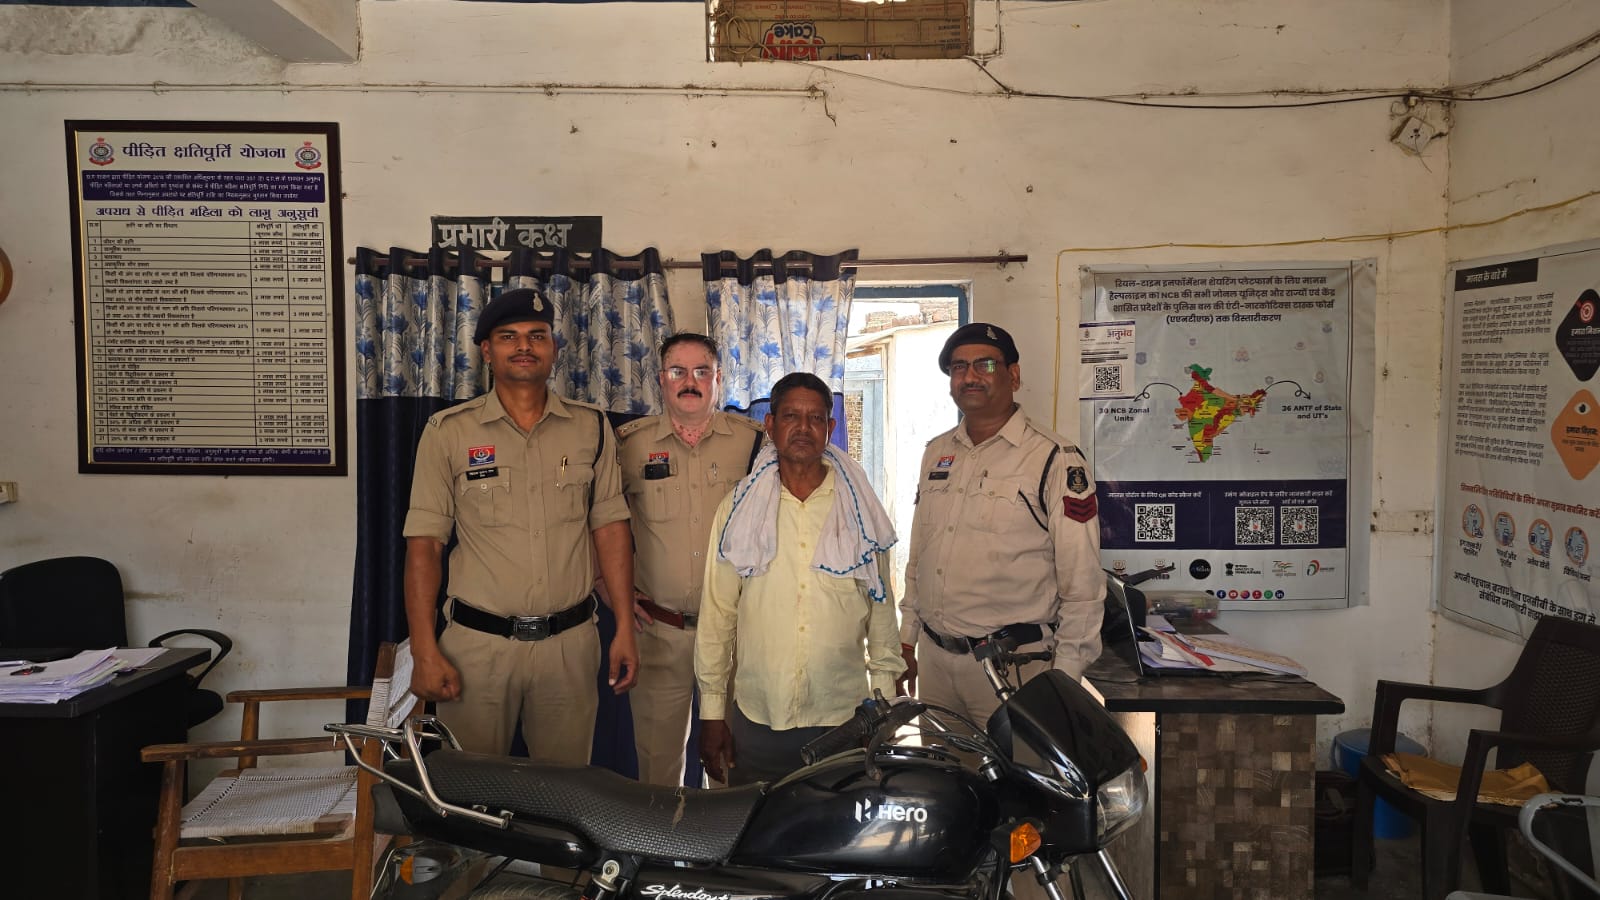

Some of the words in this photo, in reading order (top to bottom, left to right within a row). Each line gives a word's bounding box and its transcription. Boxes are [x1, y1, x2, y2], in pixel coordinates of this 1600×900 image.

[774, 23, 816, 39] Cake
[122, 142, 166, 158] पीड़ित
[174, 143, 232, 162] क्षतिपूर्ति
[240, 144, 286, 158] योजना
[96, 206, 130, 216] अपराध
[136, 205, 146, 216] से
[152, 206, 184, 218] पीड़ित
[190, 206, 222, 218] महिला
[228, 206, 242, 217] को
[249, 208, 272, 220] लागू
[278, 207, 319, 221] अनुसूची
[437, 216, 510, 250] प्रभारी
[514, 223, 573, 248] कक्ष
[1274, 276, 1282, 285] के
[1284, 276, 1300, 284] लिए
[1109, 290, 1147, 300] हेल्पलाइन
[1148, 292, 1160, 300] का
[1181, 290, 1192, 298] की
[1194, 289, 1211, 298] सभी
[1212, 289, 1237, 298] जोनल
[1238, 288, 1268, 300] यूनिट्स
[1270, 288, 1284, 297] और
[1286, 288, 1307, 297] राज्यों
[1308, 288, 1320, 296] एवं
[1113, 302, 1139, 312] शासित
[1140, 302, 1162, 312] प्रदेशों
[1163, 302, 1172, 310] के
[1173, 302, 1196, 313] पुलिस
[1213, 301, 1224, 310] की
[1216, 314, 1230, 322] तक
[1232, 312, 1282, 322] विस्तारीकरण
[1107, 330, 1133, 340] अनुभव
[1454, 571, 1470, 584] अपनी
[1470, 575, 1491, 590] पहचान
[1522, 591, 1548, 610] एनसीबी
[1549, 600, 1556, 614] के
[1558, 604, 1572, 618] साथ
[878, 804, 928, 822] Hero
